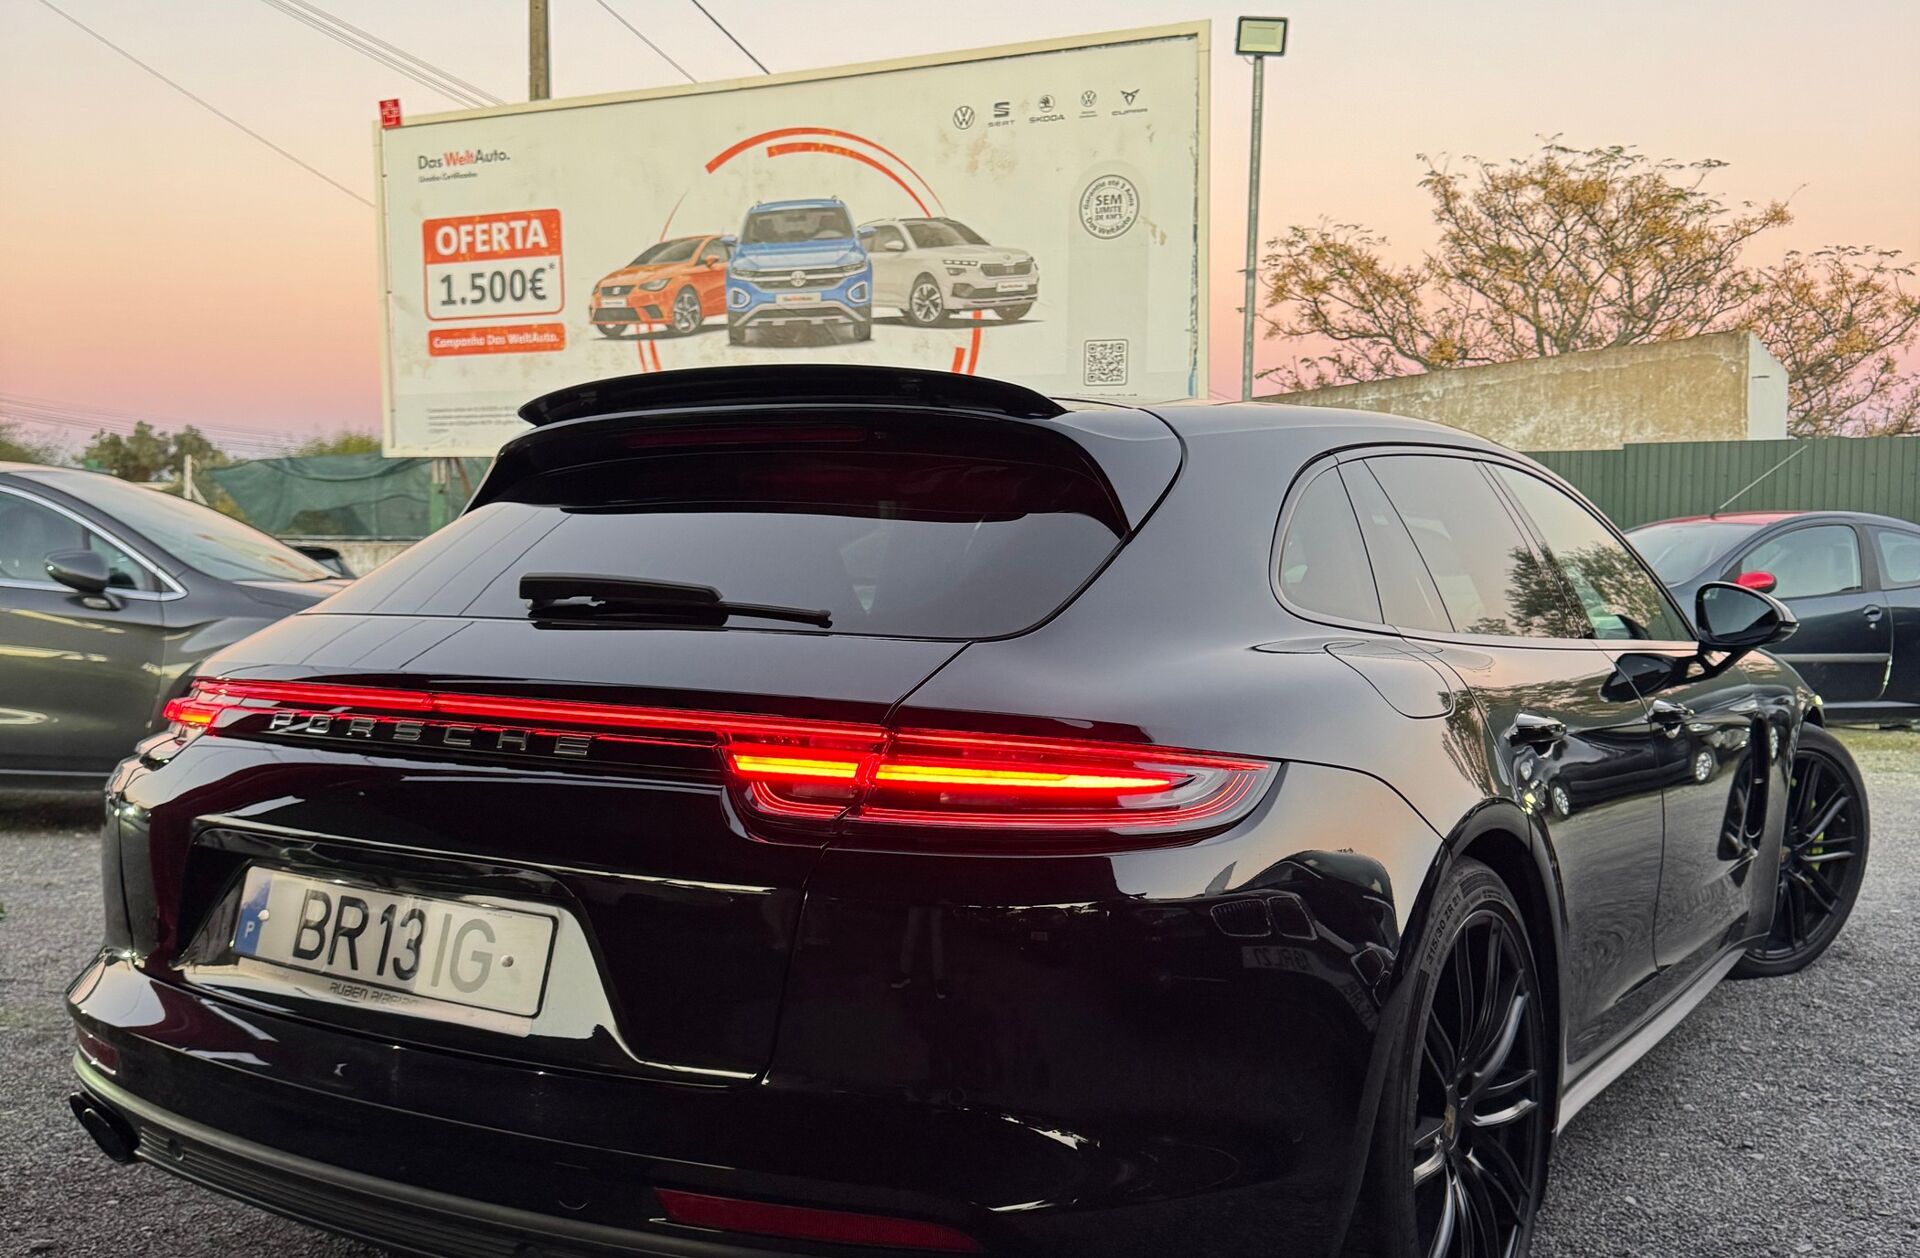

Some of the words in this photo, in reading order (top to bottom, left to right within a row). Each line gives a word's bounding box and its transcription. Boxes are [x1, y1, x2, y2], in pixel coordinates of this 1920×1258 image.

[417, 155, 443, 170] Das
[1095, 193, 1122, 206] SEM
[1095, 205, 1122, 215] LIMITE
[435, 218, 549, 256] OFERTA
[486, 334, 506, 346] Das
[268, 713, 595, 756] PORSCHE
[244, 921, 255, 939] P
